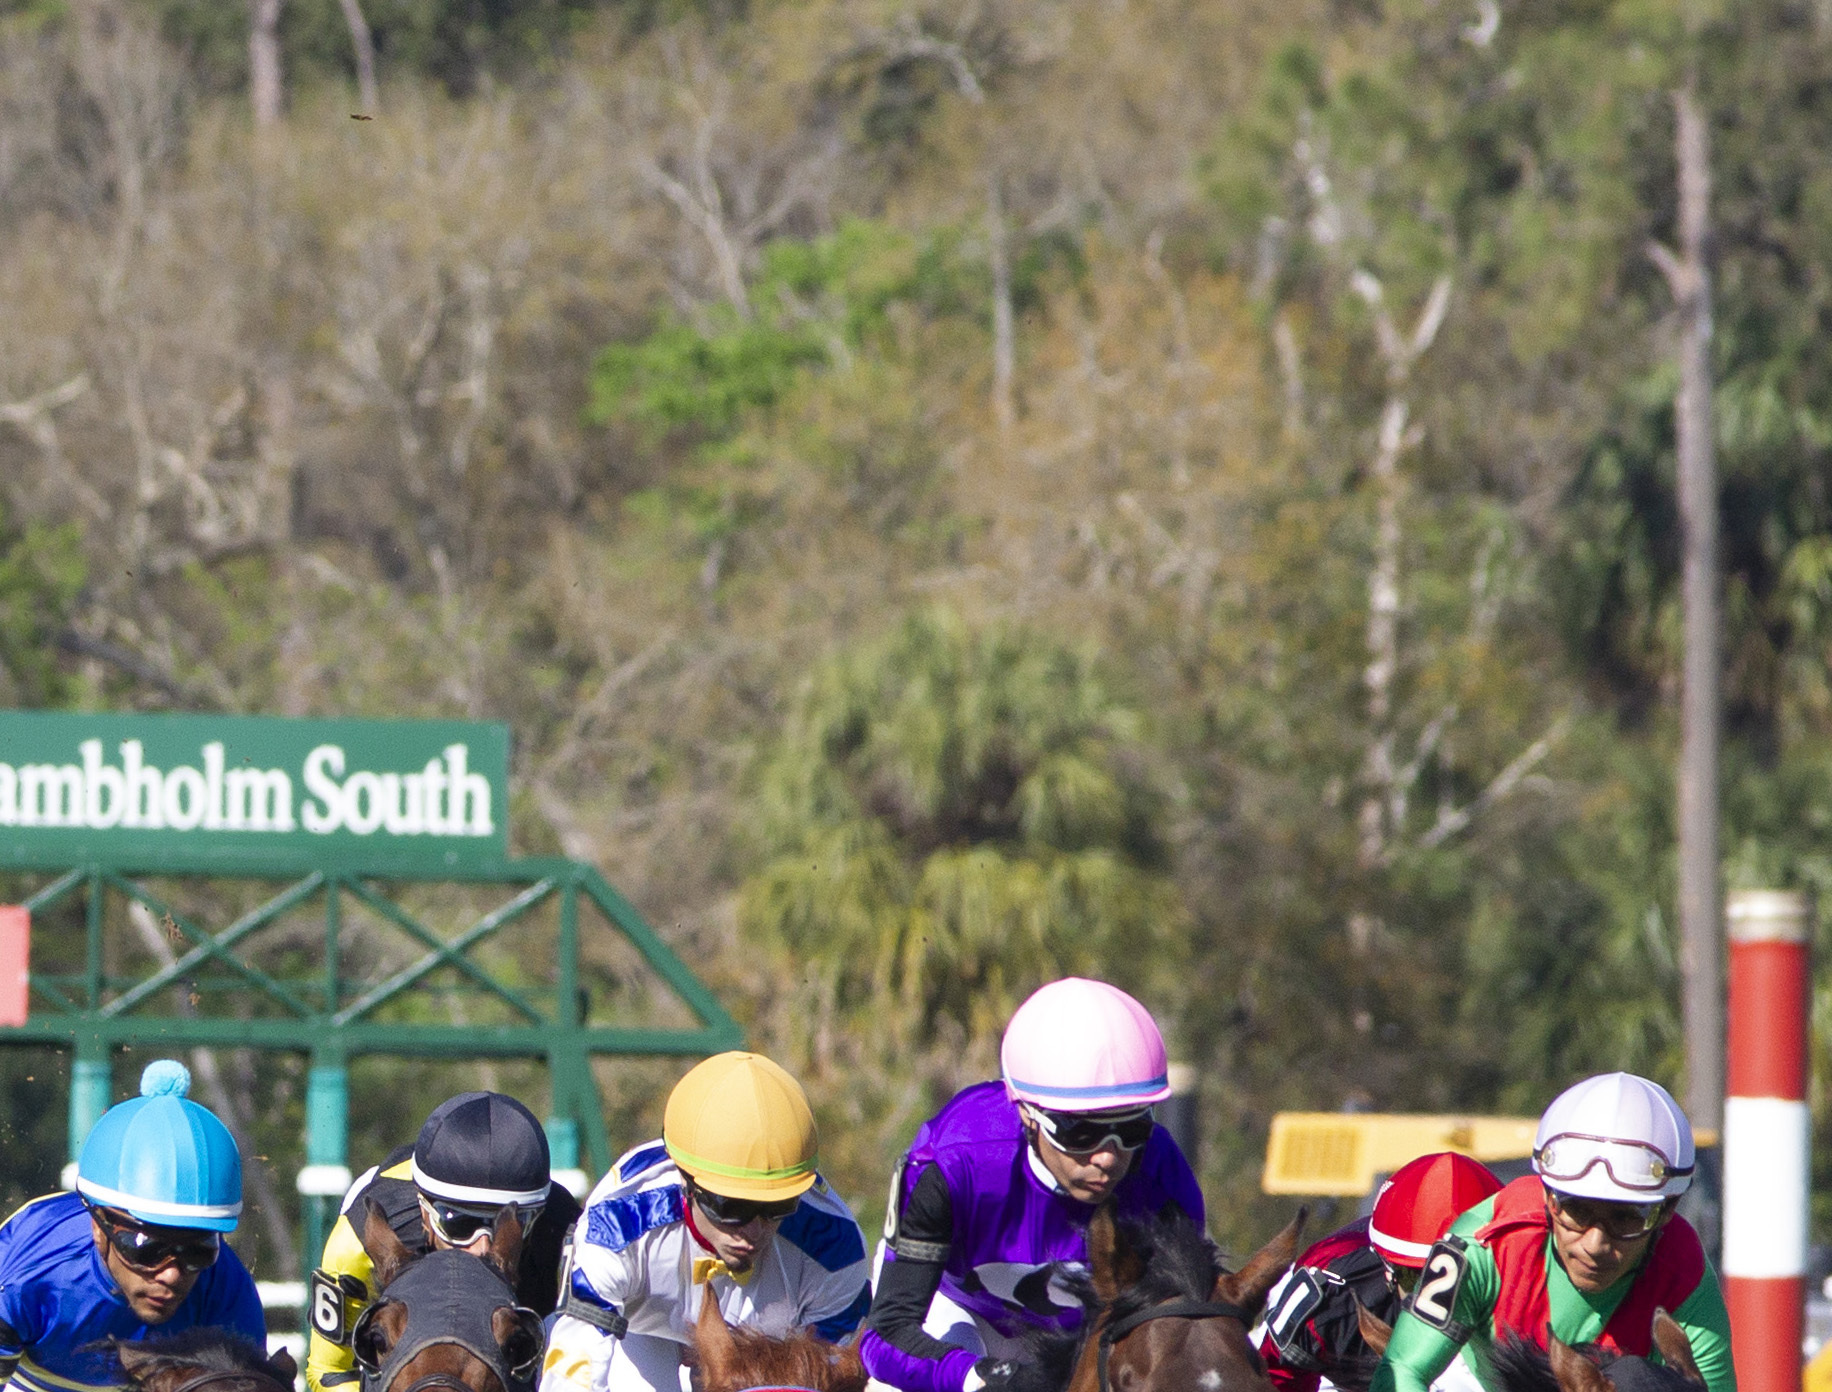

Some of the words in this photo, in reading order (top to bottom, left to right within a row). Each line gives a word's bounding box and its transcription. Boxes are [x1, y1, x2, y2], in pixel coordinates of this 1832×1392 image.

[301, 742, 494, 838] South
[314, 1283, 339, 1332] 6
[1271, 1281, 1311, 1337] 1
[1415, 1253, 1459, 1322] 2
